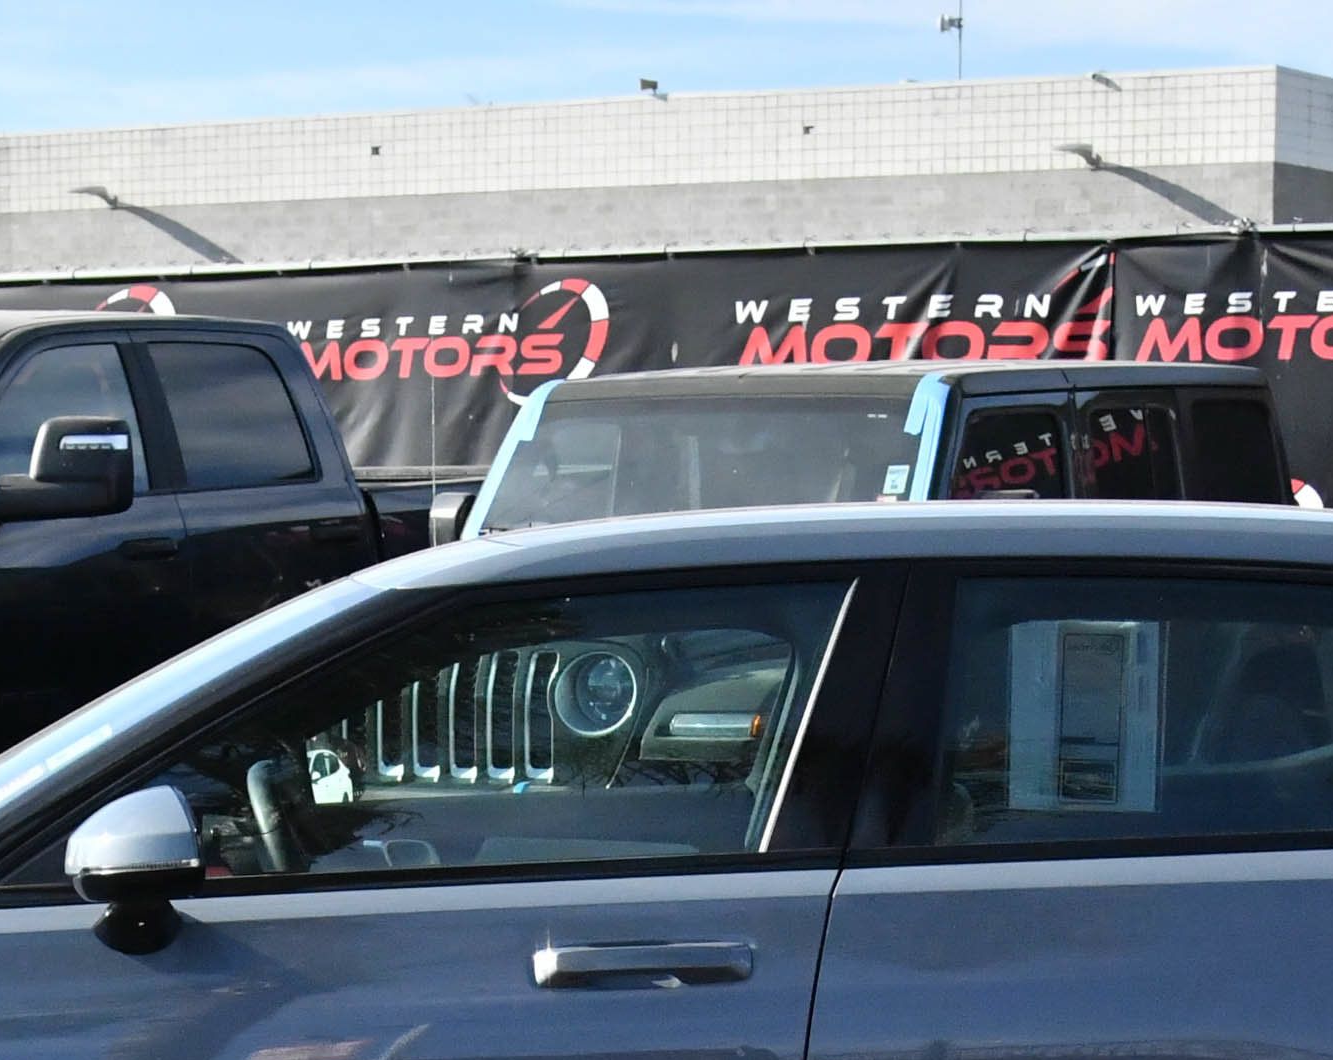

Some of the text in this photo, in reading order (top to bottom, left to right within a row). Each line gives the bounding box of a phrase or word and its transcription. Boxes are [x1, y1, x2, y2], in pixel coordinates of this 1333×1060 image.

[286, 312, 519, 340] WESTERN
[734, 293, 1052, 325] WESTERN
[299, 333, 565, 381] MOTORS
[737, 319, 1112, 366] MOTORS
